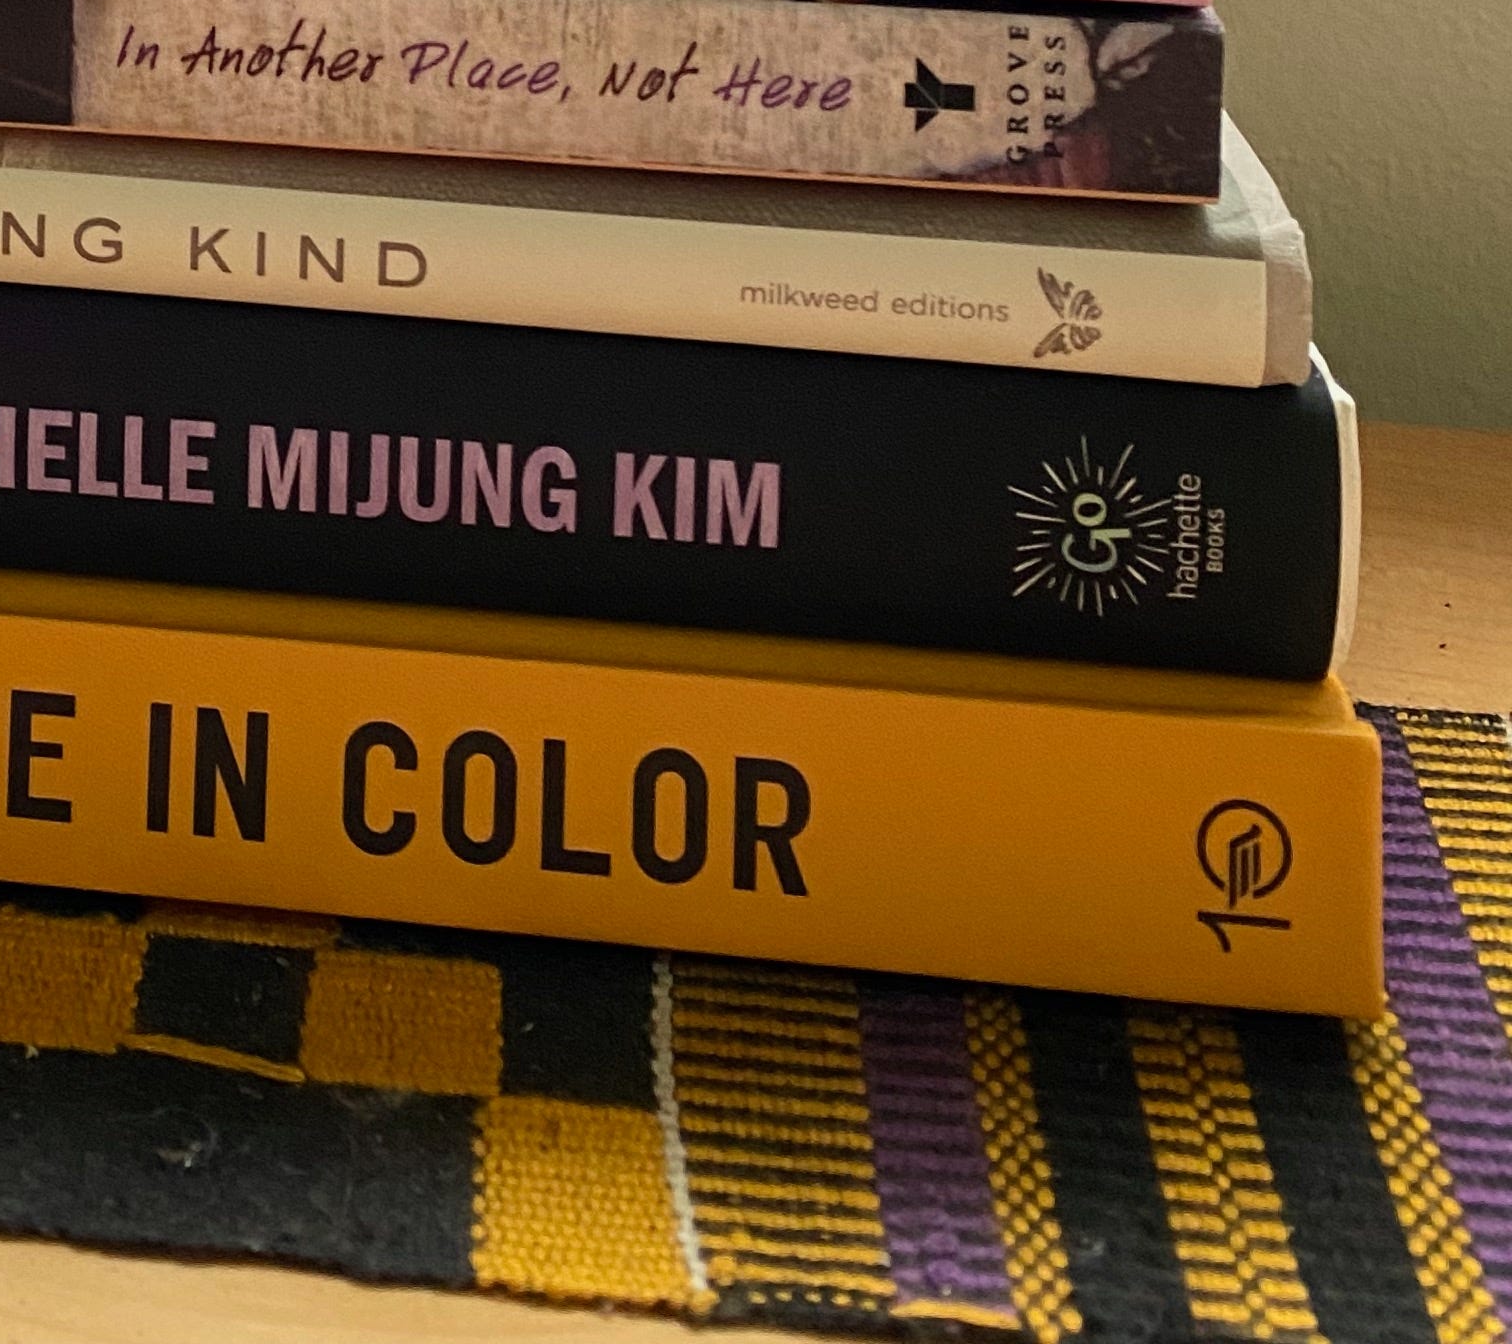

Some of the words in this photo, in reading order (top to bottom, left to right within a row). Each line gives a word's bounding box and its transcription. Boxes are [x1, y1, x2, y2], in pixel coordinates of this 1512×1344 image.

[116, 25, 158, 71] In
[181, 19, 384, 84] Another
[402, 40, 572, 102] Place,
[714, 58, 853, 112] Here
[1006, 25, 1031, 163] GROVE
[1043, 35, 1067, 158] PRESS
[189, 225, 430, 290] KIND
[740, 283, 879, 313] milkweed
[891, 292, 1010, 323] editions
[245, 422, 577, 535] MIJUNG
[611, 451, 781, 550] KIM
[1166, 472, 1202, 599] hachette
[1205, 507, 1226, 573] BOOKS
[145, 701, 270, 843] IN
[340, 720, 812, 899] COLOR
